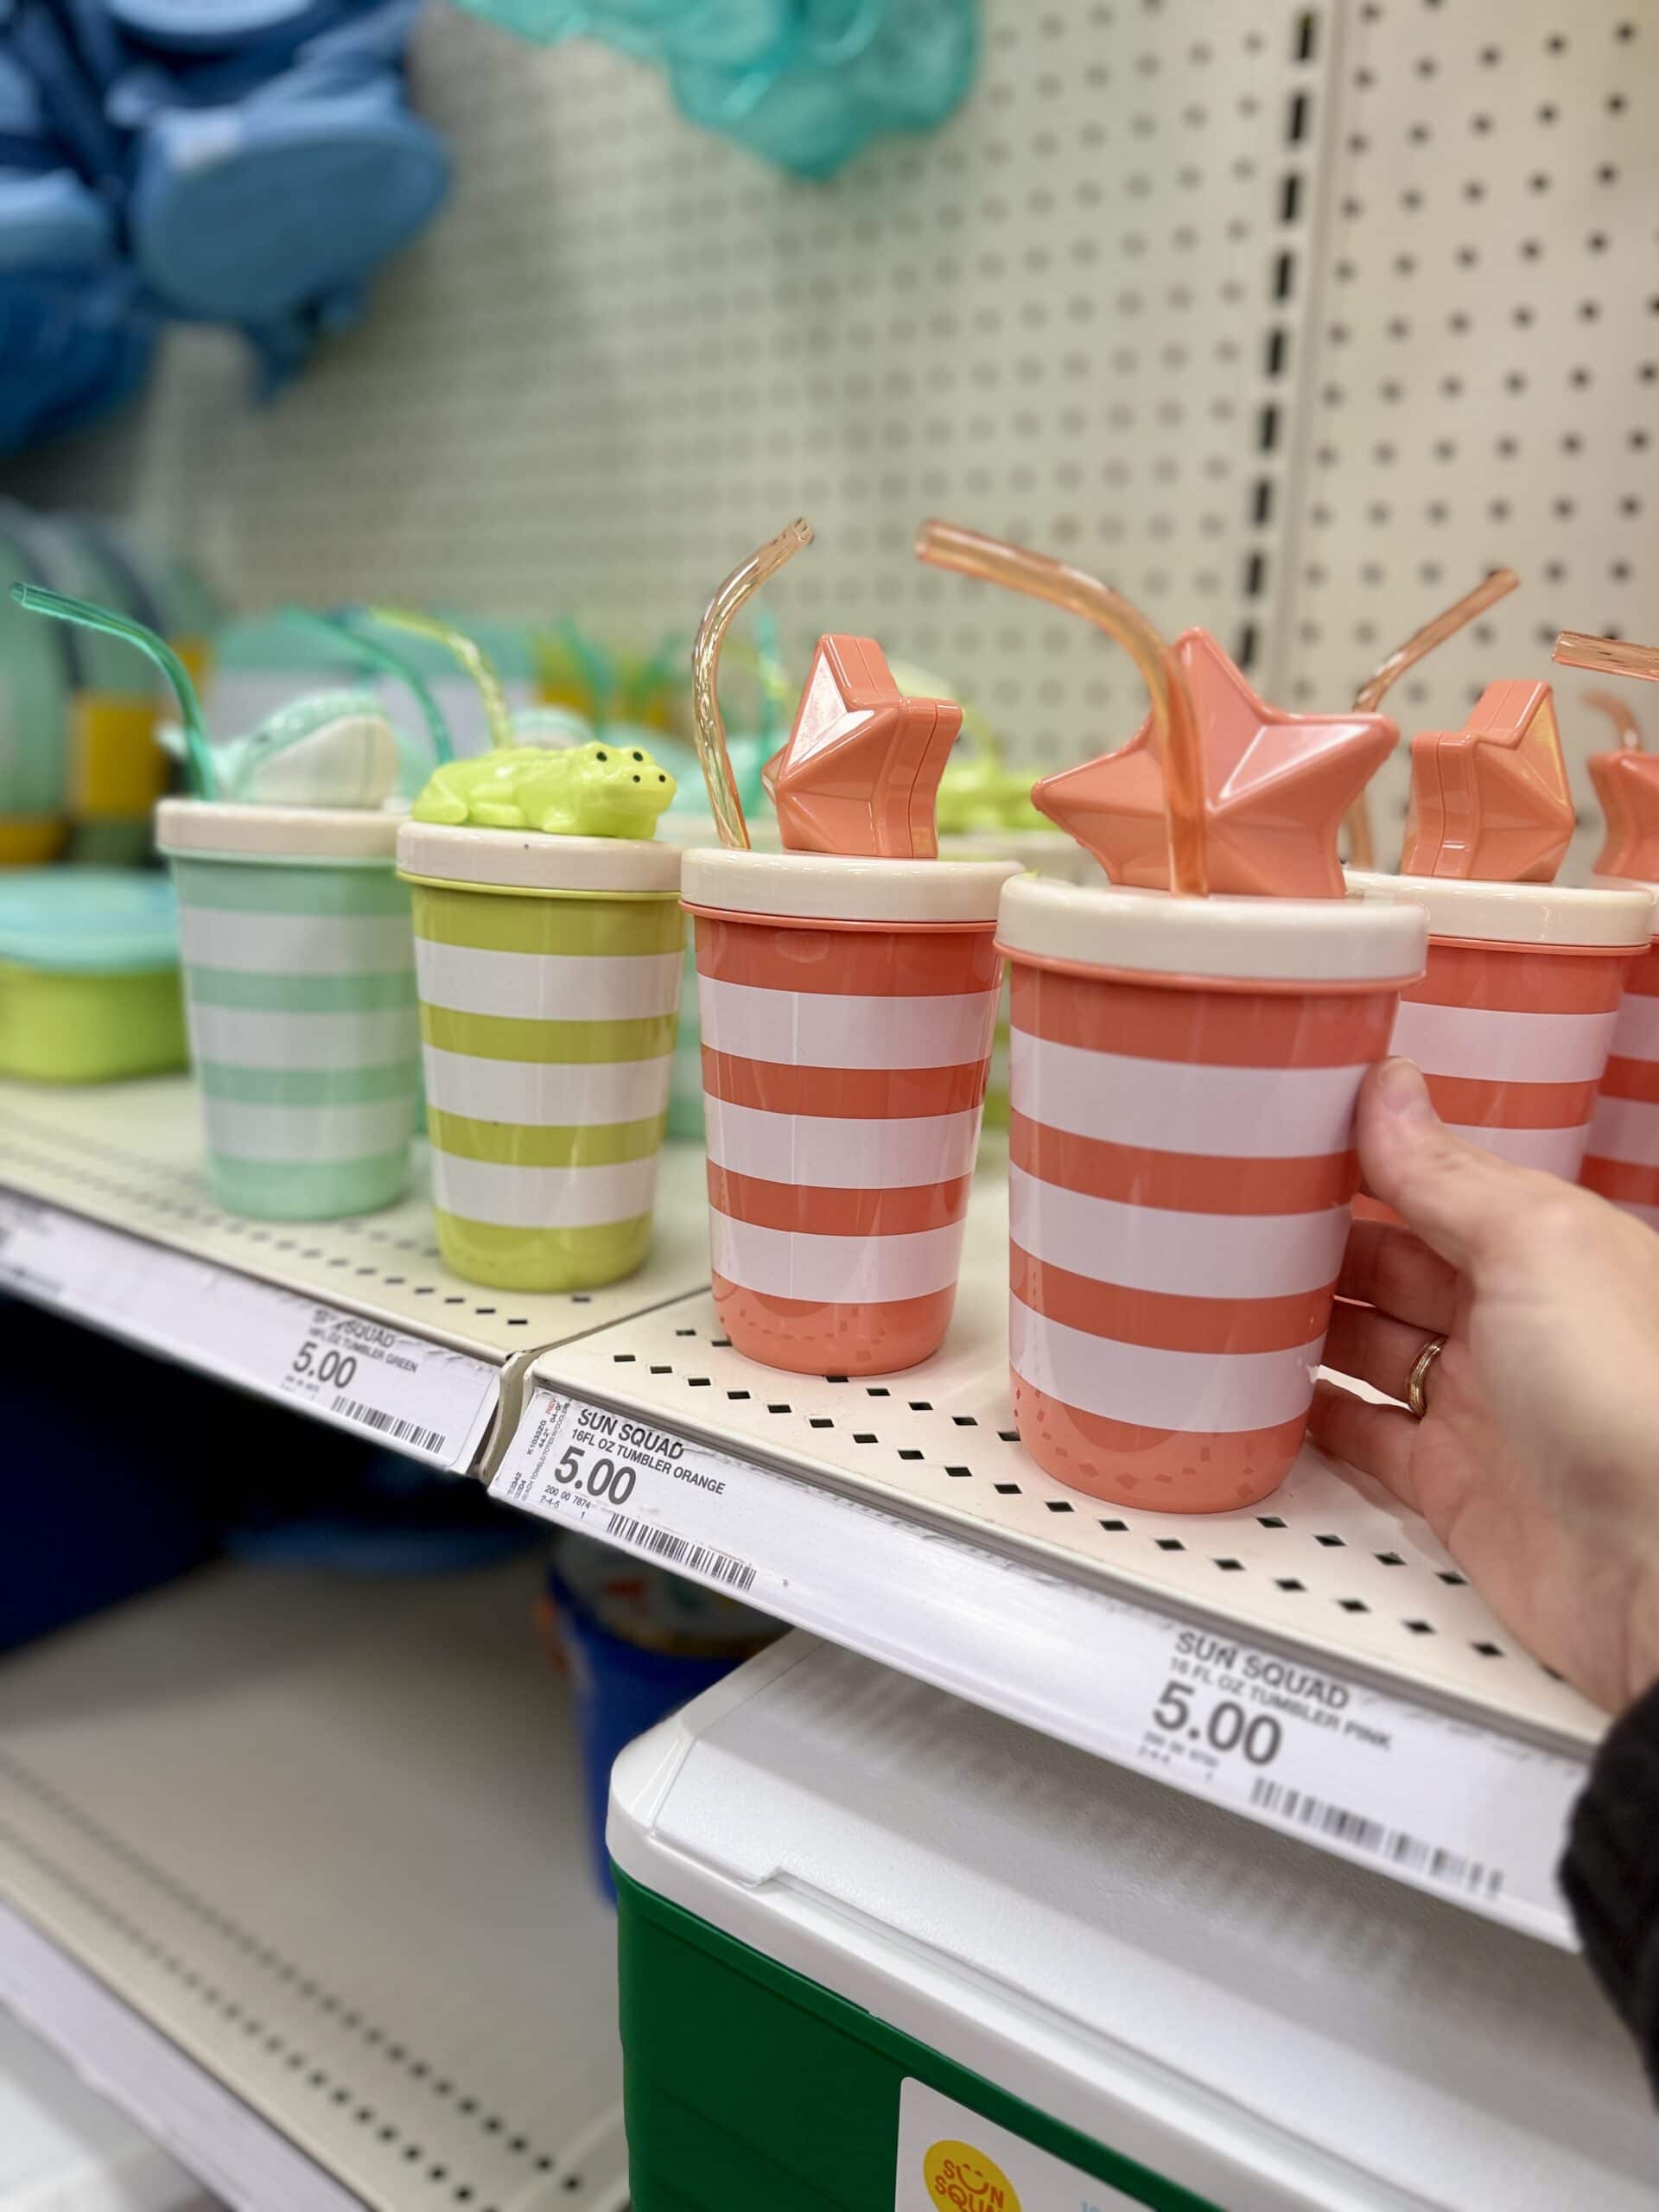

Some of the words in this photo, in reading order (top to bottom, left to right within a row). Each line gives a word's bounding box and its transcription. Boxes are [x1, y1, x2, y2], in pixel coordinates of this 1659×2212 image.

[293, 1341, 357, 1389] 5.00
[385, 1353, 419, 1373] GREEN
[577, 1408, 619, 1436] SUN
[618, 1423, 685, 1460] SQUAD
[554, 1445, 637, 1505] 5.00
[571, 1427, 595, 1446] 16FL
[598, 1438, 617, 1453] OZ
[616, 1444, 672, 1475] TUMBLER
[673, 1466, 727, 1495] ORANGE
[544, 1484, 560, 1497] 200
[560, 1491, 572, 1502] 00
[1174, 1630, 1238, 1670] SUN
[1241, 1654, 1350, 1710] SQUAD
[1153, 1680, 1283, 1766] 5.00
[1249, 1686, 1340, 1732] TUMBLER
[943, 2158, 1004, 2209] SUN
